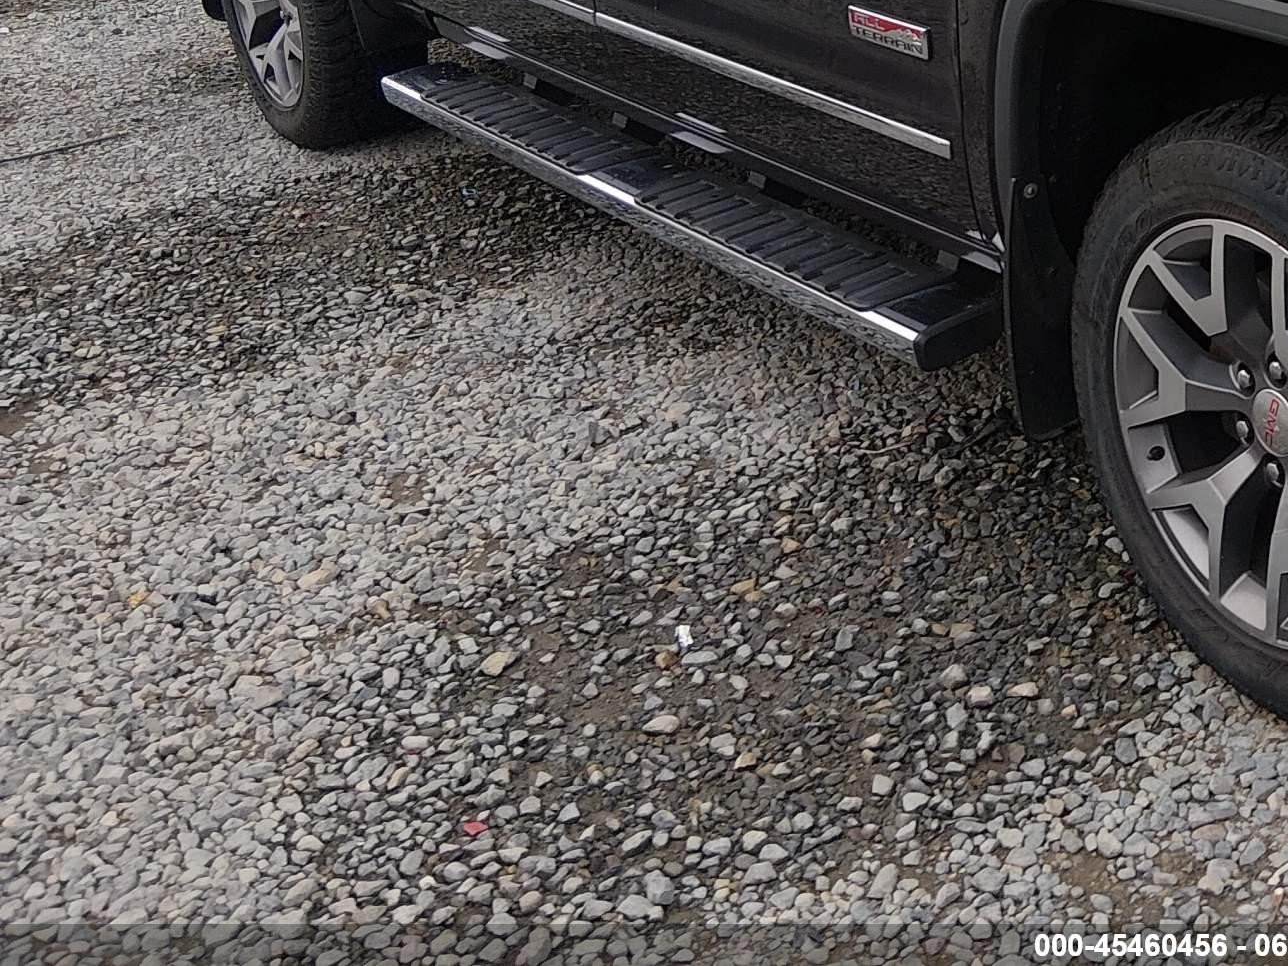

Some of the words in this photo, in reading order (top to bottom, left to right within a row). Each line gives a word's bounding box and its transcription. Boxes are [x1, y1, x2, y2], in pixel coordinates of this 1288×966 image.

[853, 12, 886, 31] ALL
[854, 25, 923, 55] TERRAIN
[1265, 398, 1280, 447] GMC
